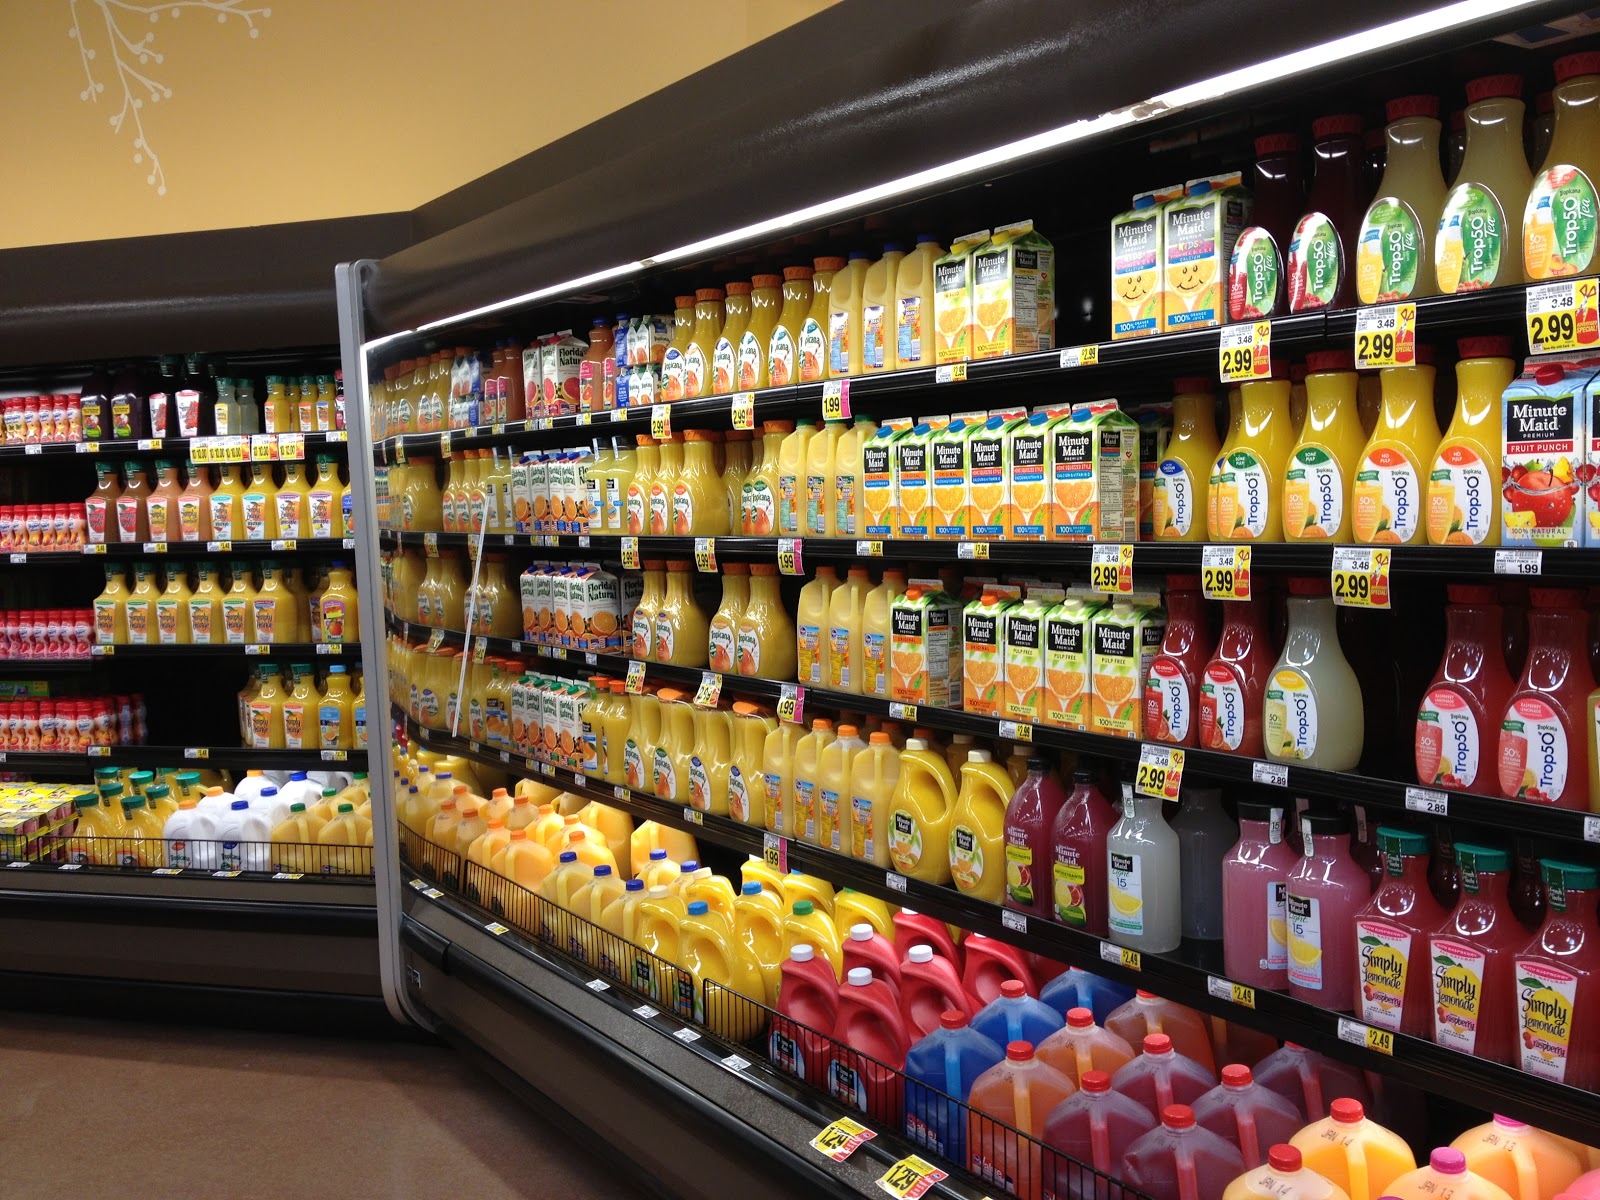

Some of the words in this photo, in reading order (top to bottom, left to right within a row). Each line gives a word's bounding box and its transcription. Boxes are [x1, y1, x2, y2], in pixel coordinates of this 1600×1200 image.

[1579, 198, 1594, 219] Tea
[1172, 211, 1210, 225] Minute
[1118, 223, 1152, 238] Minute
[1177, 224, 1205, 236] Maid
[1485, 217, 1498, 237] Tea
[1563, 197, 1578, 257] Trop50
[1122, 235, 1147, 247] Maid
[1179, 241, 1198, 251] KIDS
[1403, 231, 1415, 250] Tea
[1471, 216, 1483, 274] Trop50
[977, 256, 1005, 269] Minute
[1264, 255, 1273, 271] Tea
[1390, 230, 1401, 285] Trop50
[938, 264, 963, 277] Minute
[1313, 239, 1324, 291] Trop50
[981, 266, 1001, 278] Maid
[1253, 254, 1263, 300] Trop50
[940, 274, 959, 285] Maid
[1552, 297, 1572, 308] 3.48
[1377, 320, 1395, 328] 3.48
[1532, 313, 1573, 344] 2.99
[1577, 325, 1597, 333] SPECIAL!
[1237, 335, 1252, 344] 3.48
[1358, 334, 1394, 360] 2.99
[559, 356, 581, 366] Natur
[1222, 350, 1252, 373] 2.99
[824, 398, 839, 413] 1.99
[1513, 404, 1567, 419] Minute
[733, 410, 745, 424] 2.99
[653, 421, 664, 434] 2.99
[1519, 418, 1559, 432] Maid
[1058, 435, 1090, 448] Minute
[1102, 432, 1120, 440] Minute
[936, 445, 961, 457] Minute
[973, 443, 999, 455] Minute
[1015, 439, 1042, 452] Minute
[1062, 446, 1086, 457] Maid
[1537, 443, 1568, 451] PUNCH
[865, 450, 887, 460] Minute
[902, 447, 923, 458] Minute
[976, 452, 996, 463] Maid
[1018, 449, 1038, 460] Maid
[868, 458, 884, 468] Maid
[904, 456, 921, 466] Maid
[939, 454, 958, 465] Maid
[1175, 483, 1185, 525] Trop50
[1247, 478, 1260, 525] Trop50
[1321, 474, 1333, 523] Trop50
[1395, 477, 1409, 528] Trop50
[1467, 476, 1481, 530] Trop50
[1059, 525, 1073, 533] 100%
[696, 553, 709, 567] 2.99
[780, 553, 794, 569] 1.99
[1352, 561, 1369, 570] 3.48
[1518, 564, 1539, 574] 1.99
[1094, 566, 1118, 586] 2.99
[1205, 570, 1233, 591] 2.99
[588, 581, 616, 590] Florida's
[1335, 575, 1368, 599] 2.99
[588, 590, 616, 602] Natural
[895, 611, 919, 622] Minute
[967, 617, 993, 629] Minute
[898, 620, 916, 631] Maid
[1011, 620, 1036, 633] Minute
[1051, 623, 1080, 637] Minute
[971, 627, 989, 638] Maid
[1014, 630, 1032, 641] Maid
[1098, 626, 1131, 640] Minute
[1054, 634, 1075, 646] Maid
[1102, 637, 1126, 649] Maid
[780, 700, 794, 715] 1.99
[1148, 700, 1158, 708] 50%
[1172, 687, 1181, 731] Trop50
[1520, 706, 1541, 714] LEMONADE
[1052, 711, 1064, 719] 100%
[1225, 692, 1235, 738] Trop50
[1269, 714, 1281, 722] 50%
[1297, 699, 1309, 746] Trop50
[1537, 724, 1557, 732] Tropicana
[1421, 737, 1436, 746] 50%
[1455, 722, 1469, 773] Trop50
[1504, 748, 1520, 757] 50%
[1155, 757, 1169, 766] 3.48
[1540, 733, 1557, 787] Trop50
[1139, 767, 1165, 791] 2.99
[1271, 776, 1286, 785] 2.89
[1427, 803, 1446, 813] 2.89
[896, 816, 911, 824] Minute
[898, 822, 908, 830] Maid
[1007, 827, 1028, 839] Minute
[1010, 837, 1025, 846] Maid
[765, 850, 779, 866] 1.99
[1055, 846, 1080, 858] Minute
[1058, 856, 1076, 865] Maid
[1112, 856, 1131, 865] Minute
[1114, 862, 1128, 870] Maid
[1116, 877, 1127, 887] 15
[1290, 905, 1305, 914] Maid
[1014, 923, 1026, 932] 2.79
[1293, 923, 1303, 934] 15
[1123, 950, 1138, 965] $2.49
[1362, 946, 1403, 977] Simply
[1362, 967, 1401, 990] Lemonade
[1435, 965, 1476, 1000] Simply
[1234, 985, 1252, 1003] $2.49
[1373, 991, 1401, 1008] raspberry
[1435, 989, 1476, 1014] Lemonade
[1521, 988, 1568, 1025] Simply
[1446, 1014, 1476, 1031] raspberry
[1521, 1012, 1566, 1038] Lemonade
[1369, 1030, 1390, 1049] $2.49
[1533, 1038, 1565, 1058] raspberry
[819, 1126, 849, 1150] 1.29
[1321, 1129, 1338, 1141] JAN
[1341, 1136, 1354, 1147] 14
[1483, 1134, 1500, 1146] JAN
[1503, 1141, 1516, 1152] 13
[886, 1164, 920, 1191] 1.29
[1259, 1177, 1276, 1190] JAN
[1277, 1184, 1293, 1195] 14
[1418, 1180, 1438, 1194] JAN
[1440, 1187, 1454, 1200] 13
